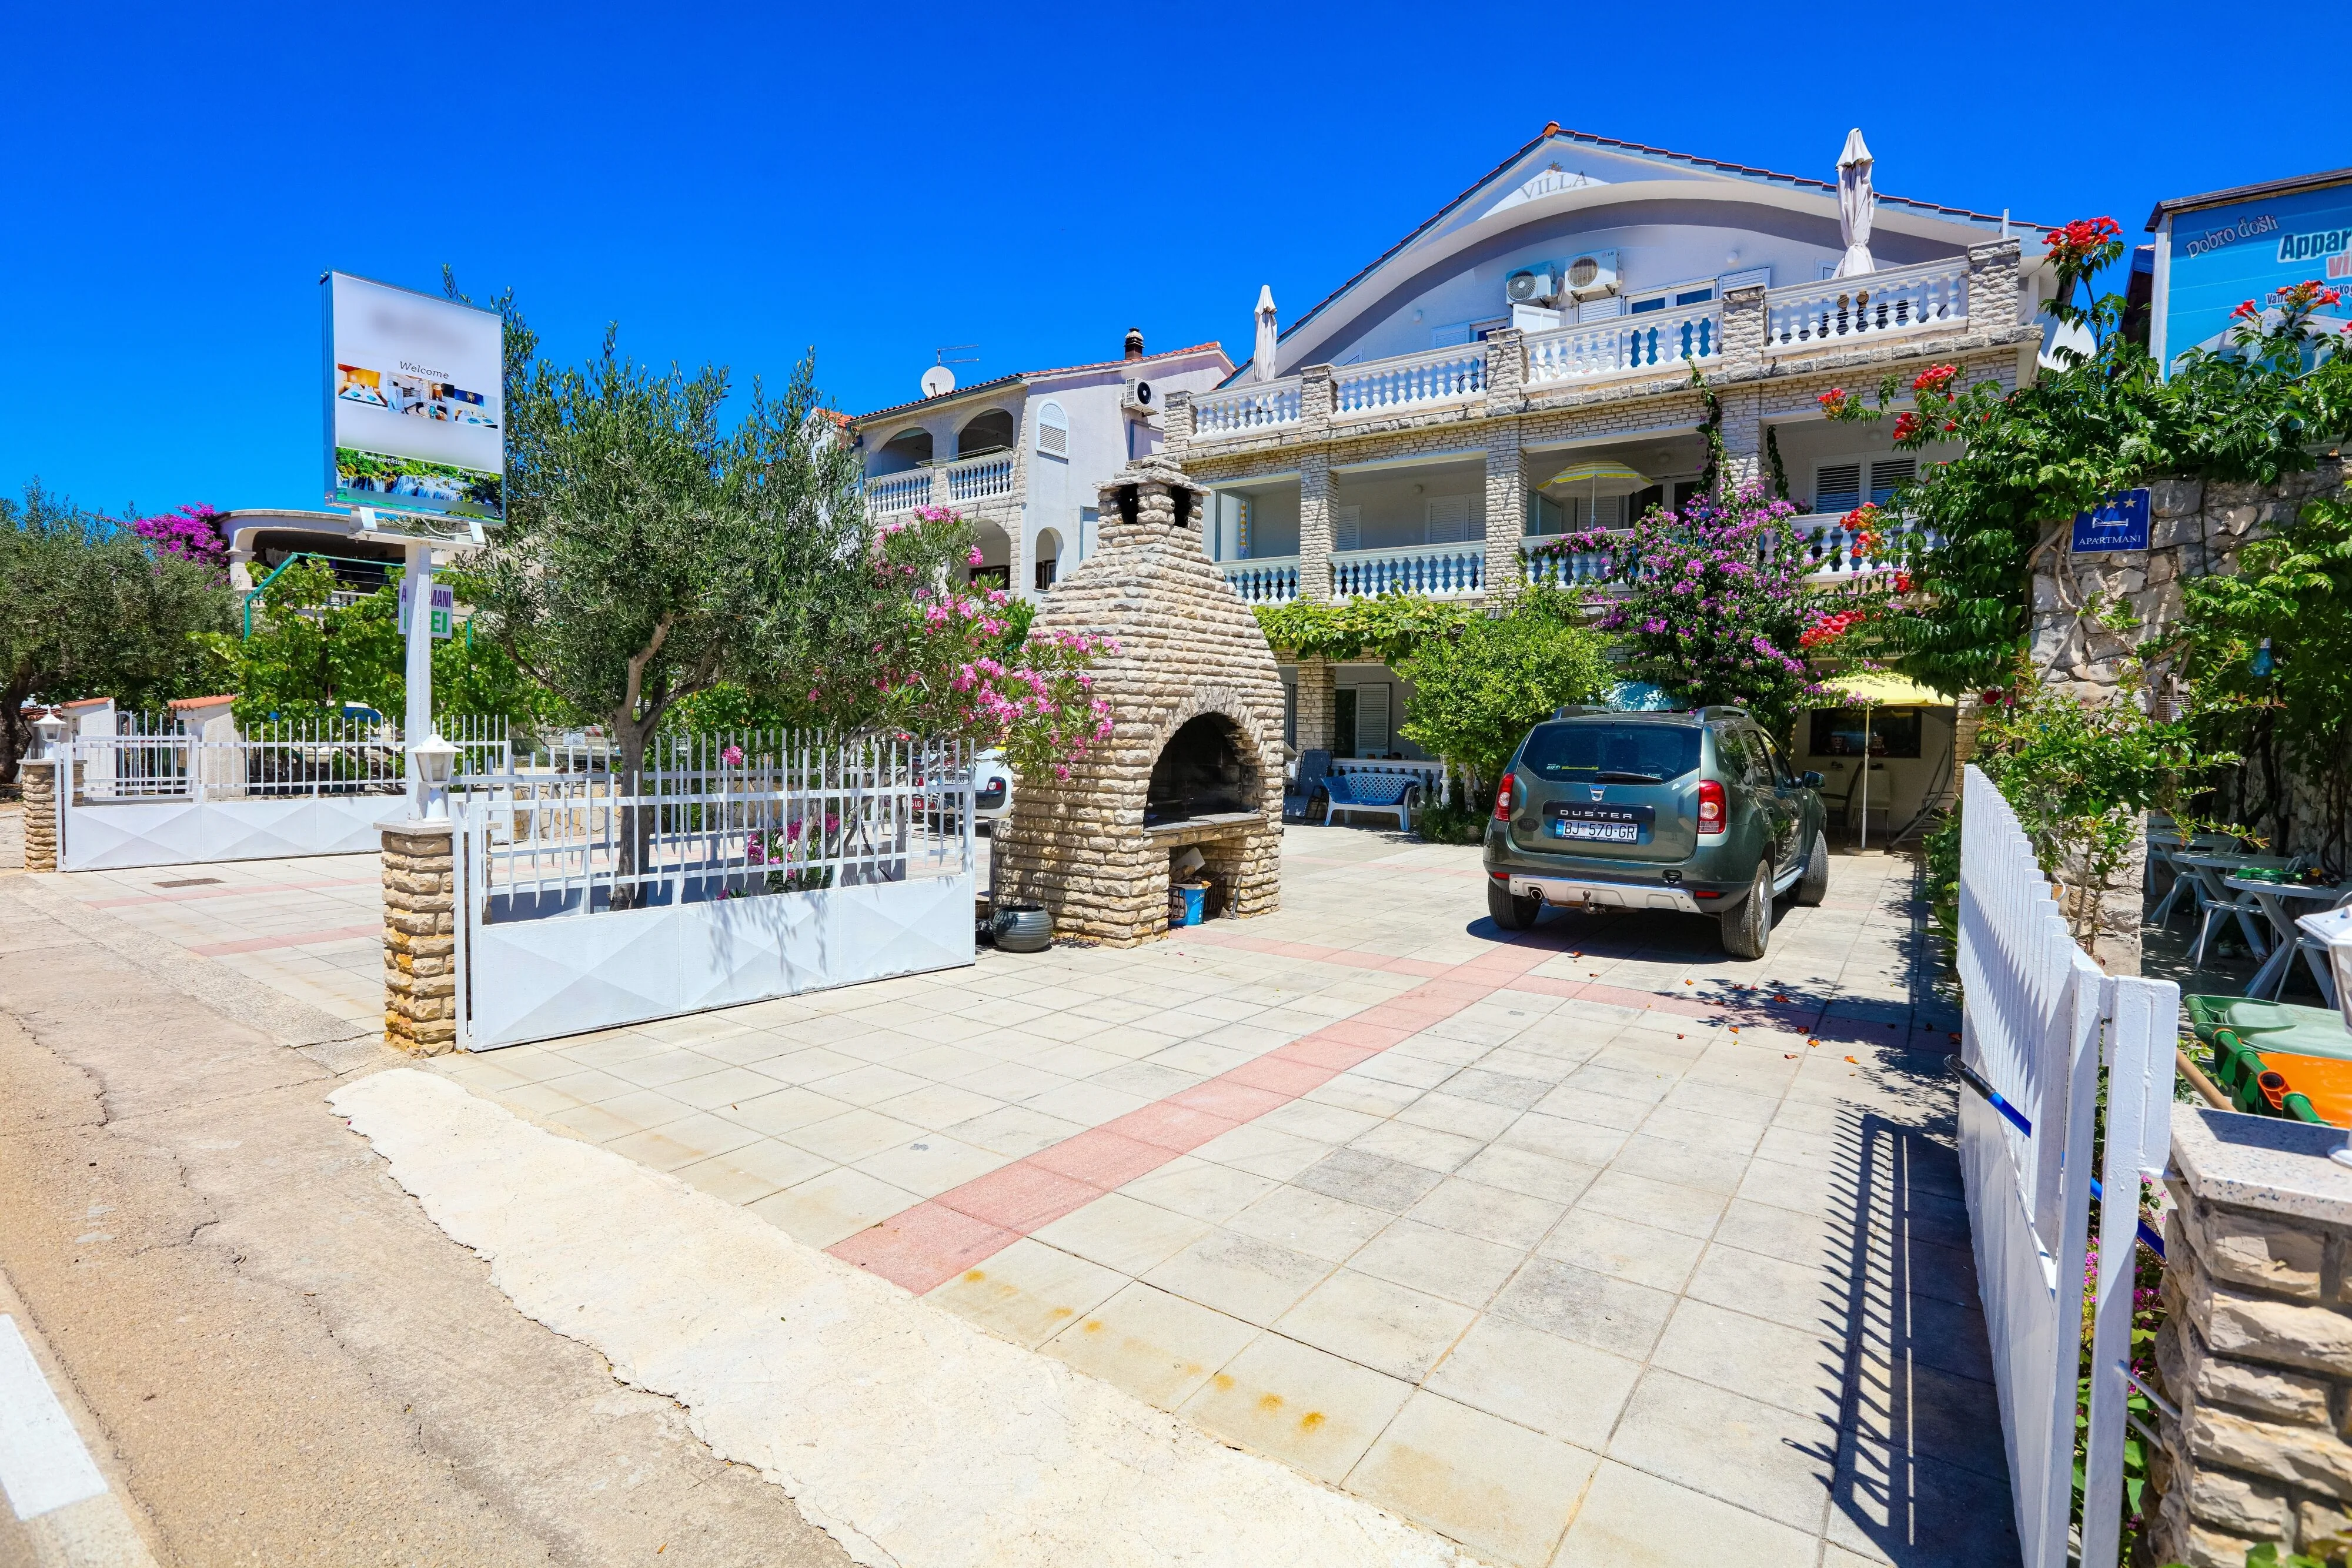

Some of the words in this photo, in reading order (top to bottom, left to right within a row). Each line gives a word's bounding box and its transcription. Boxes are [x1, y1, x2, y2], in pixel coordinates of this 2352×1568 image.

[1521, 170, 1589, 199] VILLA
[2186, 228, 2236, 259] Dobro
[2237, 215, 2279, 238] došli
[2328, 251, 2352, 278] vi
[399, 360, 449, 379] Welcome
[358, 452, 377, 462] Free
[377, 456, 407, 467] parking
[457, 468, 475, 477] Free
[2078, 534, 2141, 546] APARTMANI
[1560, 810, 1632, 819] DUSTER
[1565, 821, 1580, 834] BJ
[1589, 823, 1635, 839] 570-GR
